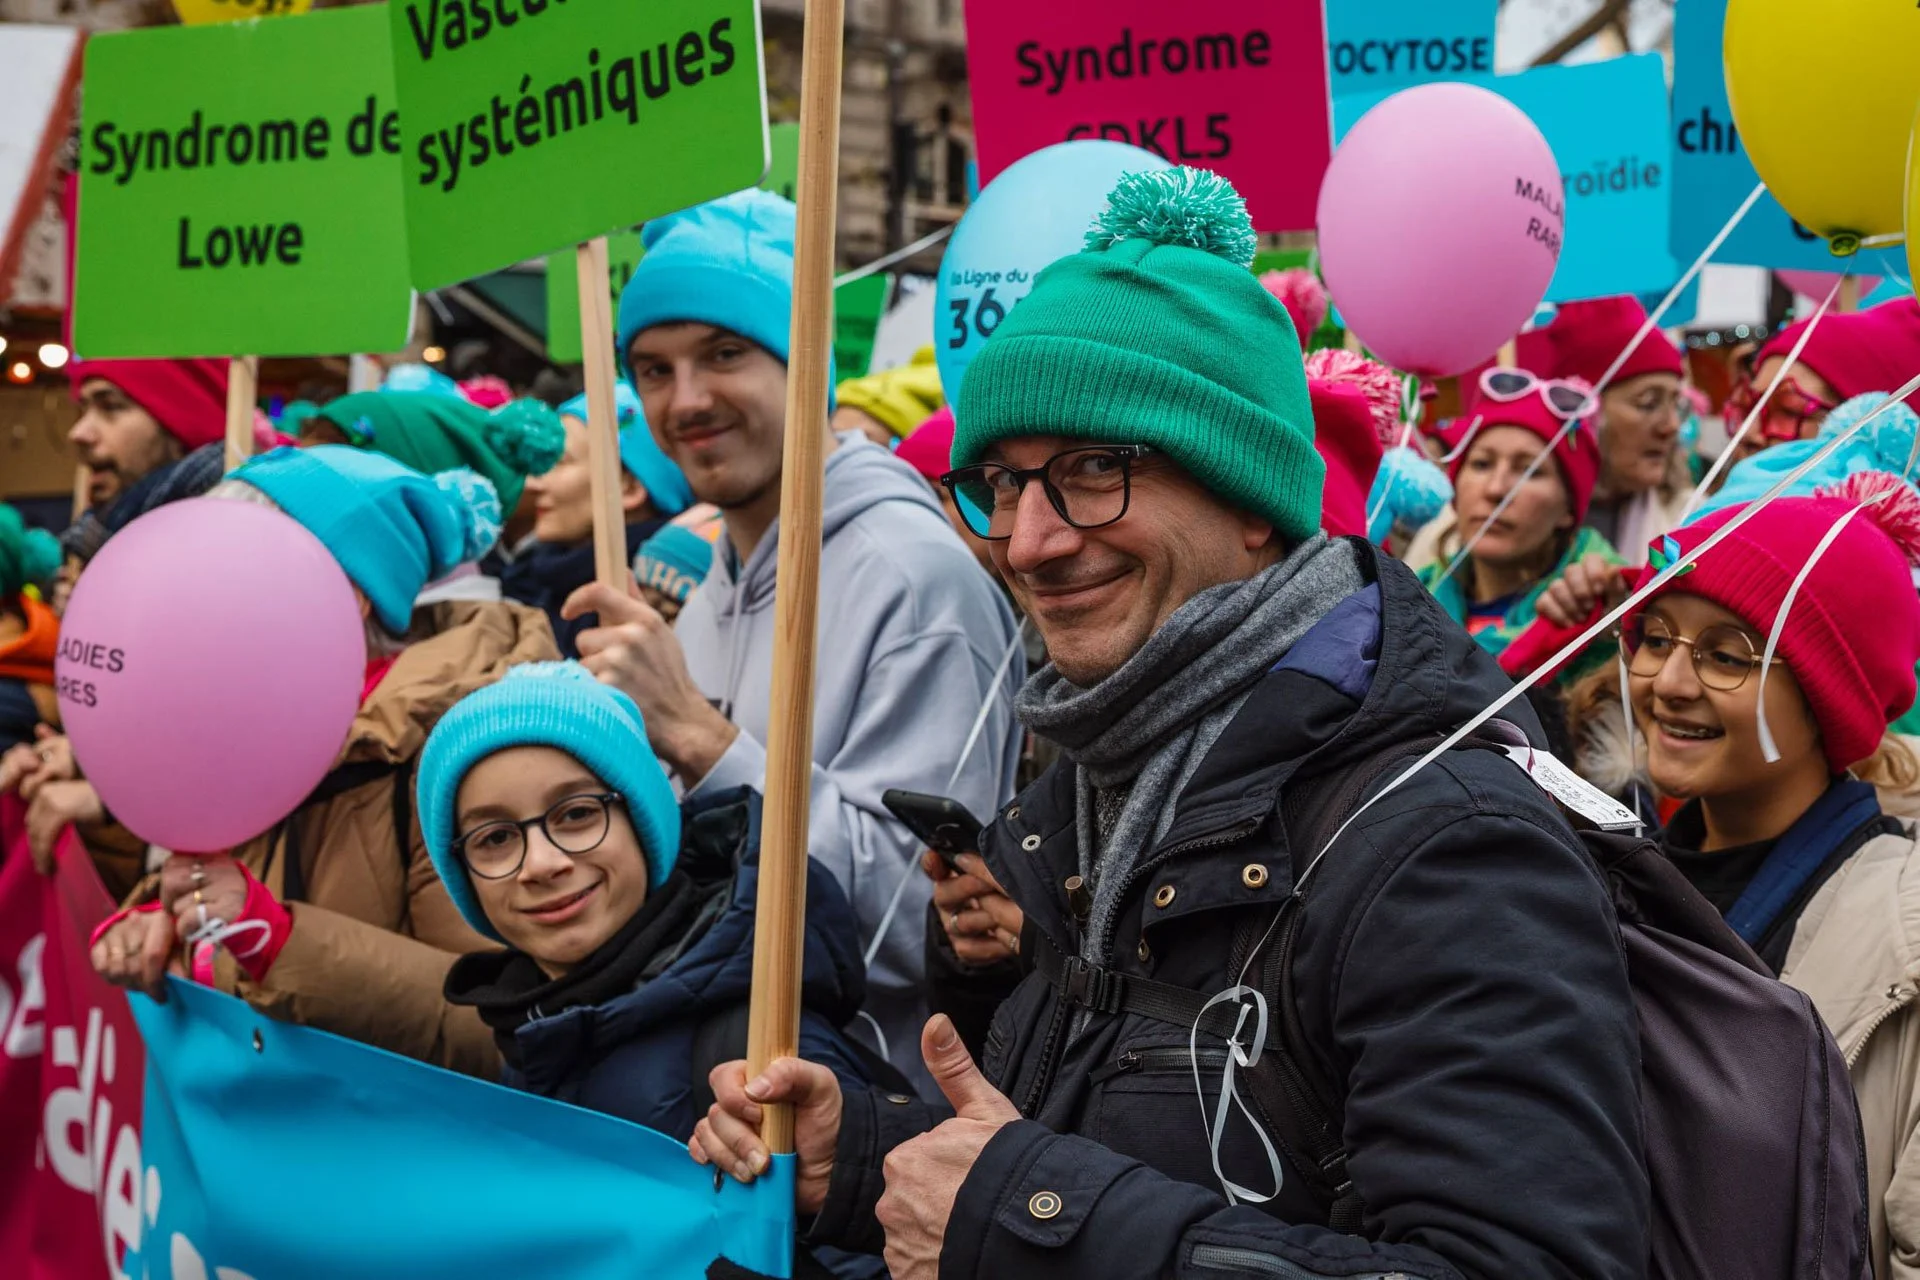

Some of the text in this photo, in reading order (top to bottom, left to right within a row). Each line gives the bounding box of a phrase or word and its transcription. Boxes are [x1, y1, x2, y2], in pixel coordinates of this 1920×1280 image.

[1015, 27, 1273, 96] Syndrome
[1330, 36, 1490, 76] OCYTOSE
[416, 17, 737, 193] systémiques
[89, 109, 332, 187] Syndrome
[177, 216, 305, 269] Lowe
[963, 269, 1002, 289] Ligne
[1005, 268, 1029, 283] du
